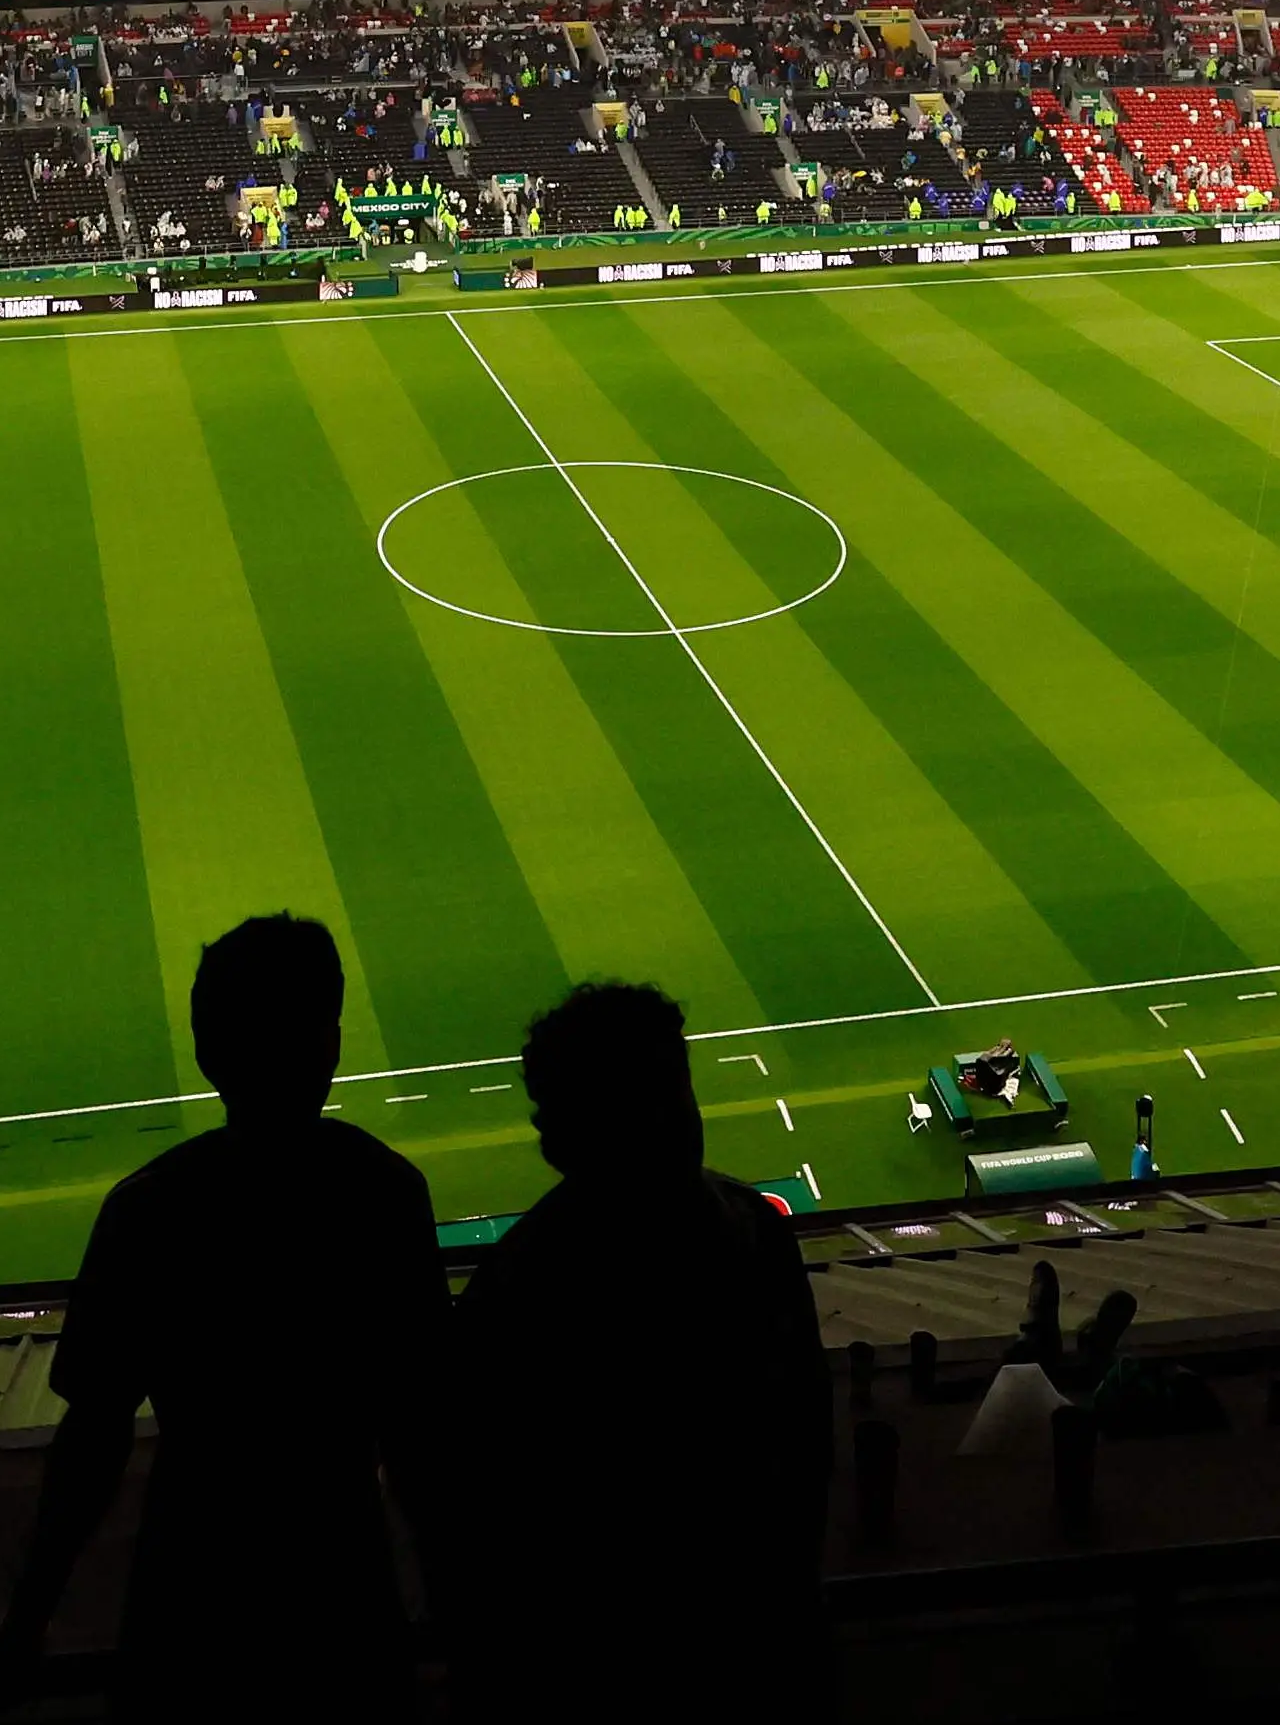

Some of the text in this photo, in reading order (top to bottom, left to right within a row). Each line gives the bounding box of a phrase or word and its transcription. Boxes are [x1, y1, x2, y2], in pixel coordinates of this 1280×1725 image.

[352, 202, 430, 213] MEXICO CITY
[1134, 234, 1160, 246] FIFA
[983, 244, 1009, 256] FIFA
[827, 254, 855, 267] FIFA
[666, 263, 695, 276] FIFA
[155, 289, 258, 309] NO RACISM FIFA
[5, 299, 48, 317] RACISM
[52, 299, 83, 313] FIFA
